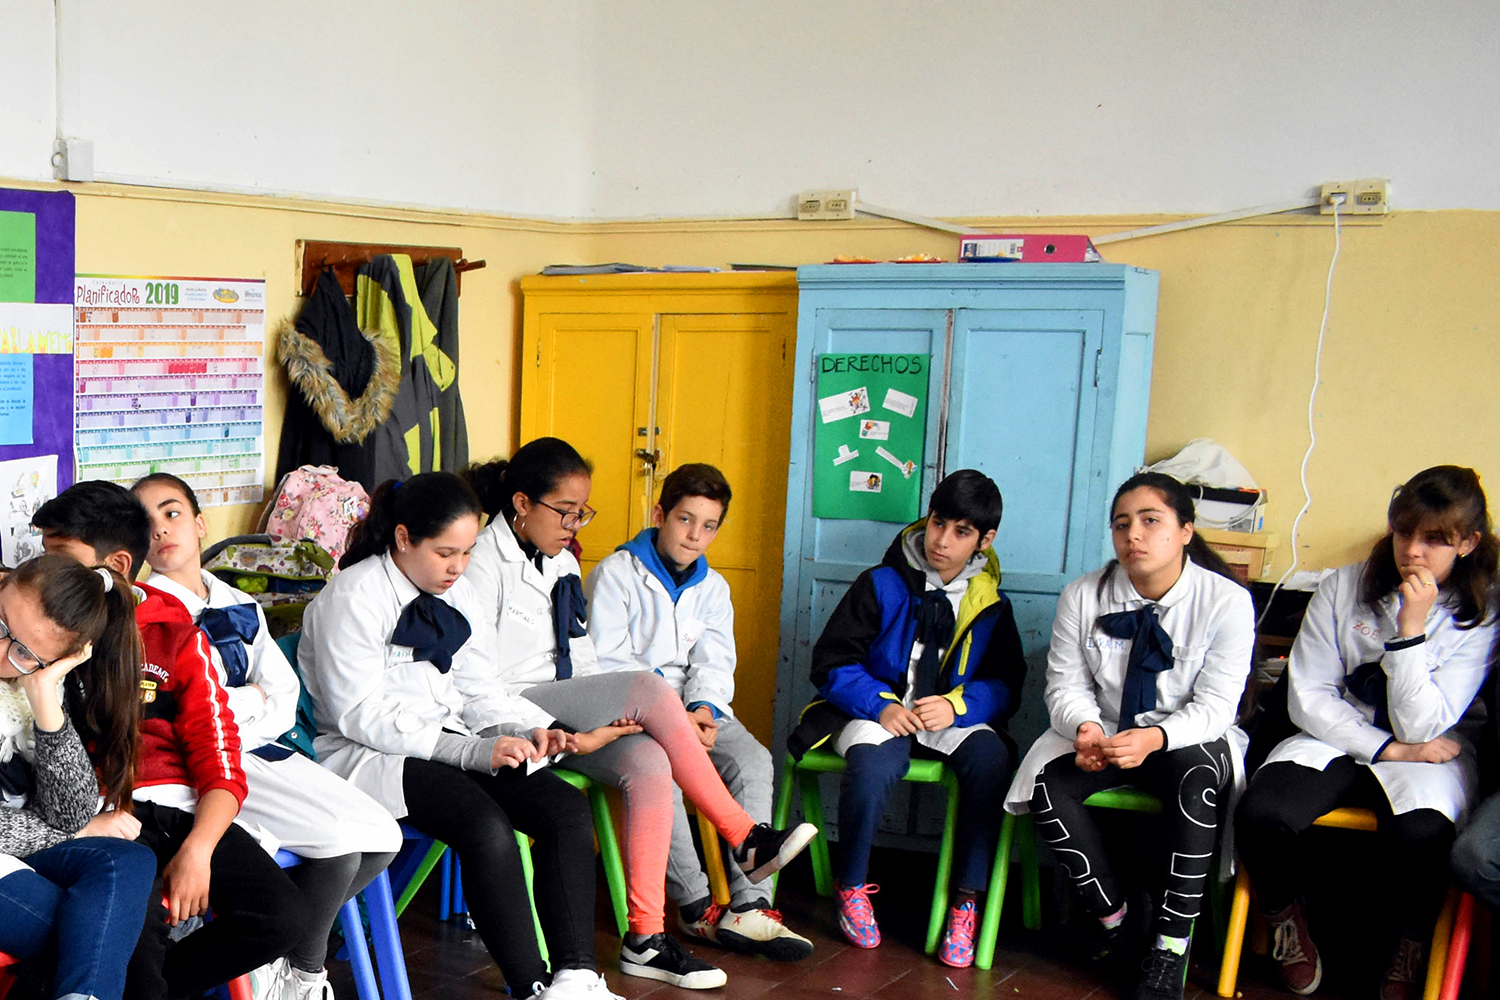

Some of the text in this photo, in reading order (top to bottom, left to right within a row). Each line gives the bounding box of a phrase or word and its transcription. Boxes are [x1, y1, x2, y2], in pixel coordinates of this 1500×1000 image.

[145, 282, 180, 305] 2019
[821, 355, 923, 375] DERECHOS
[145, 691, 153, 701] 6
